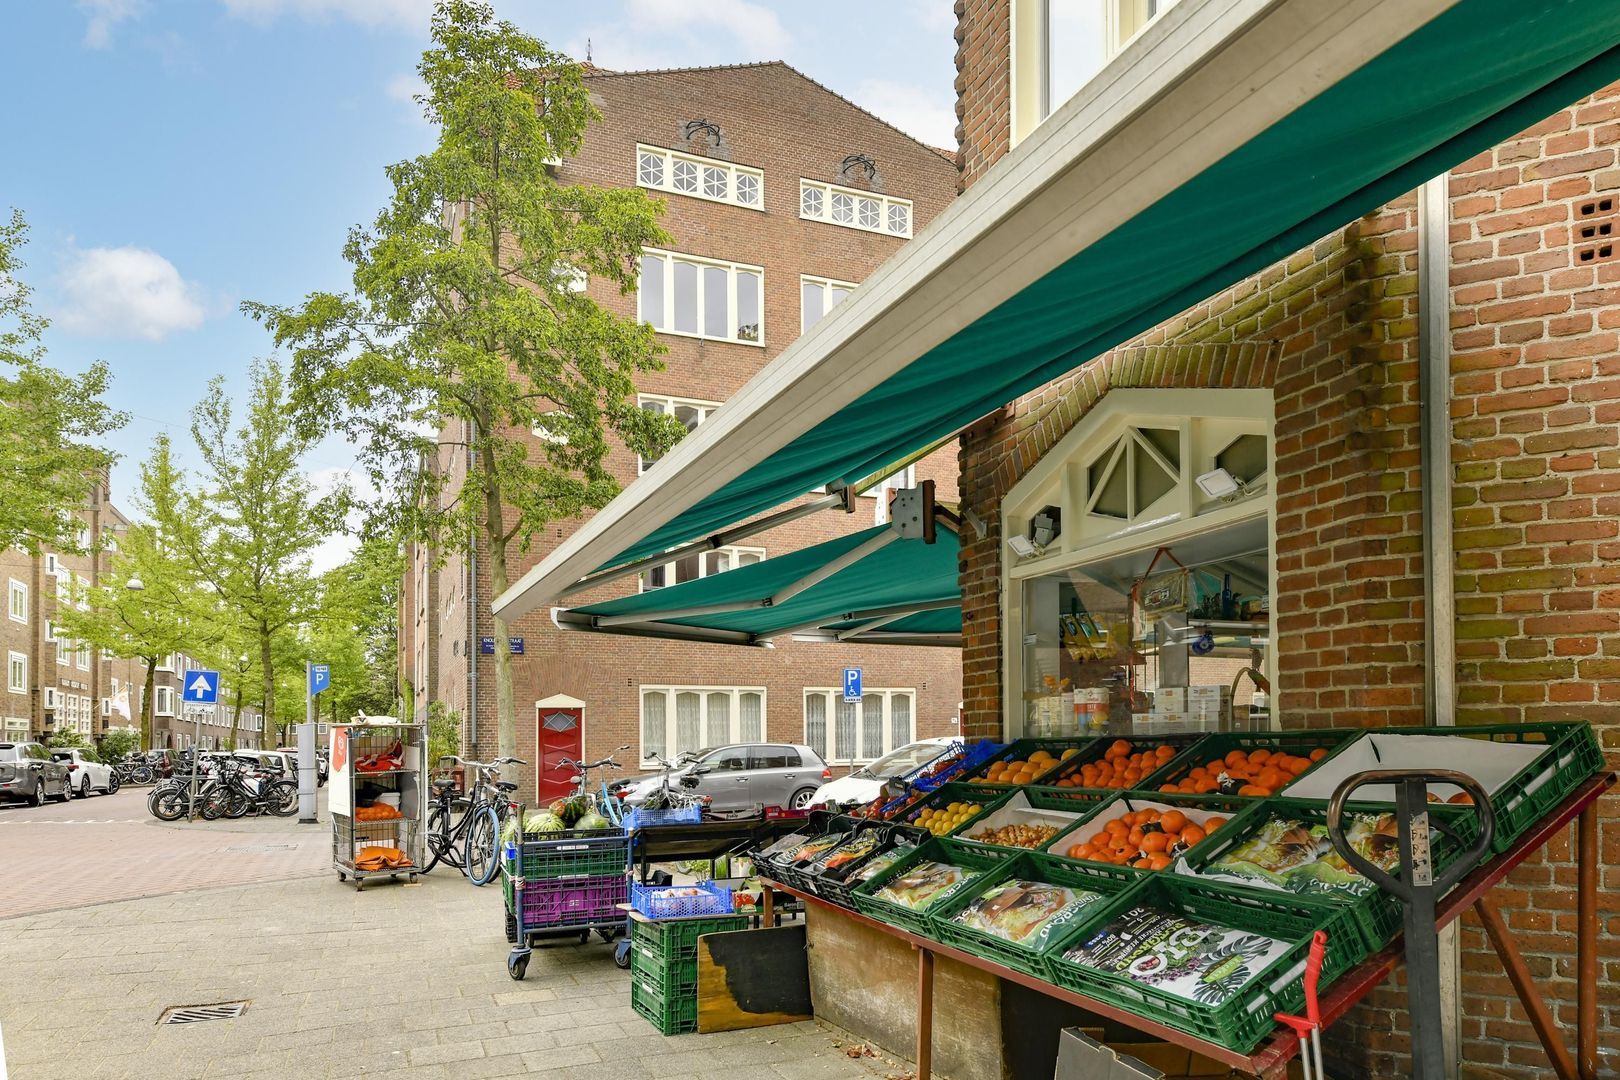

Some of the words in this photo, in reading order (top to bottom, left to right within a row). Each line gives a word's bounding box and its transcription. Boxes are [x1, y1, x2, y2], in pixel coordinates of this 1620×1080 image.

[316, 673, 324, 685] P
[847, 670, 858, 685] P
[1128, 926, 1214, 976] BIO
